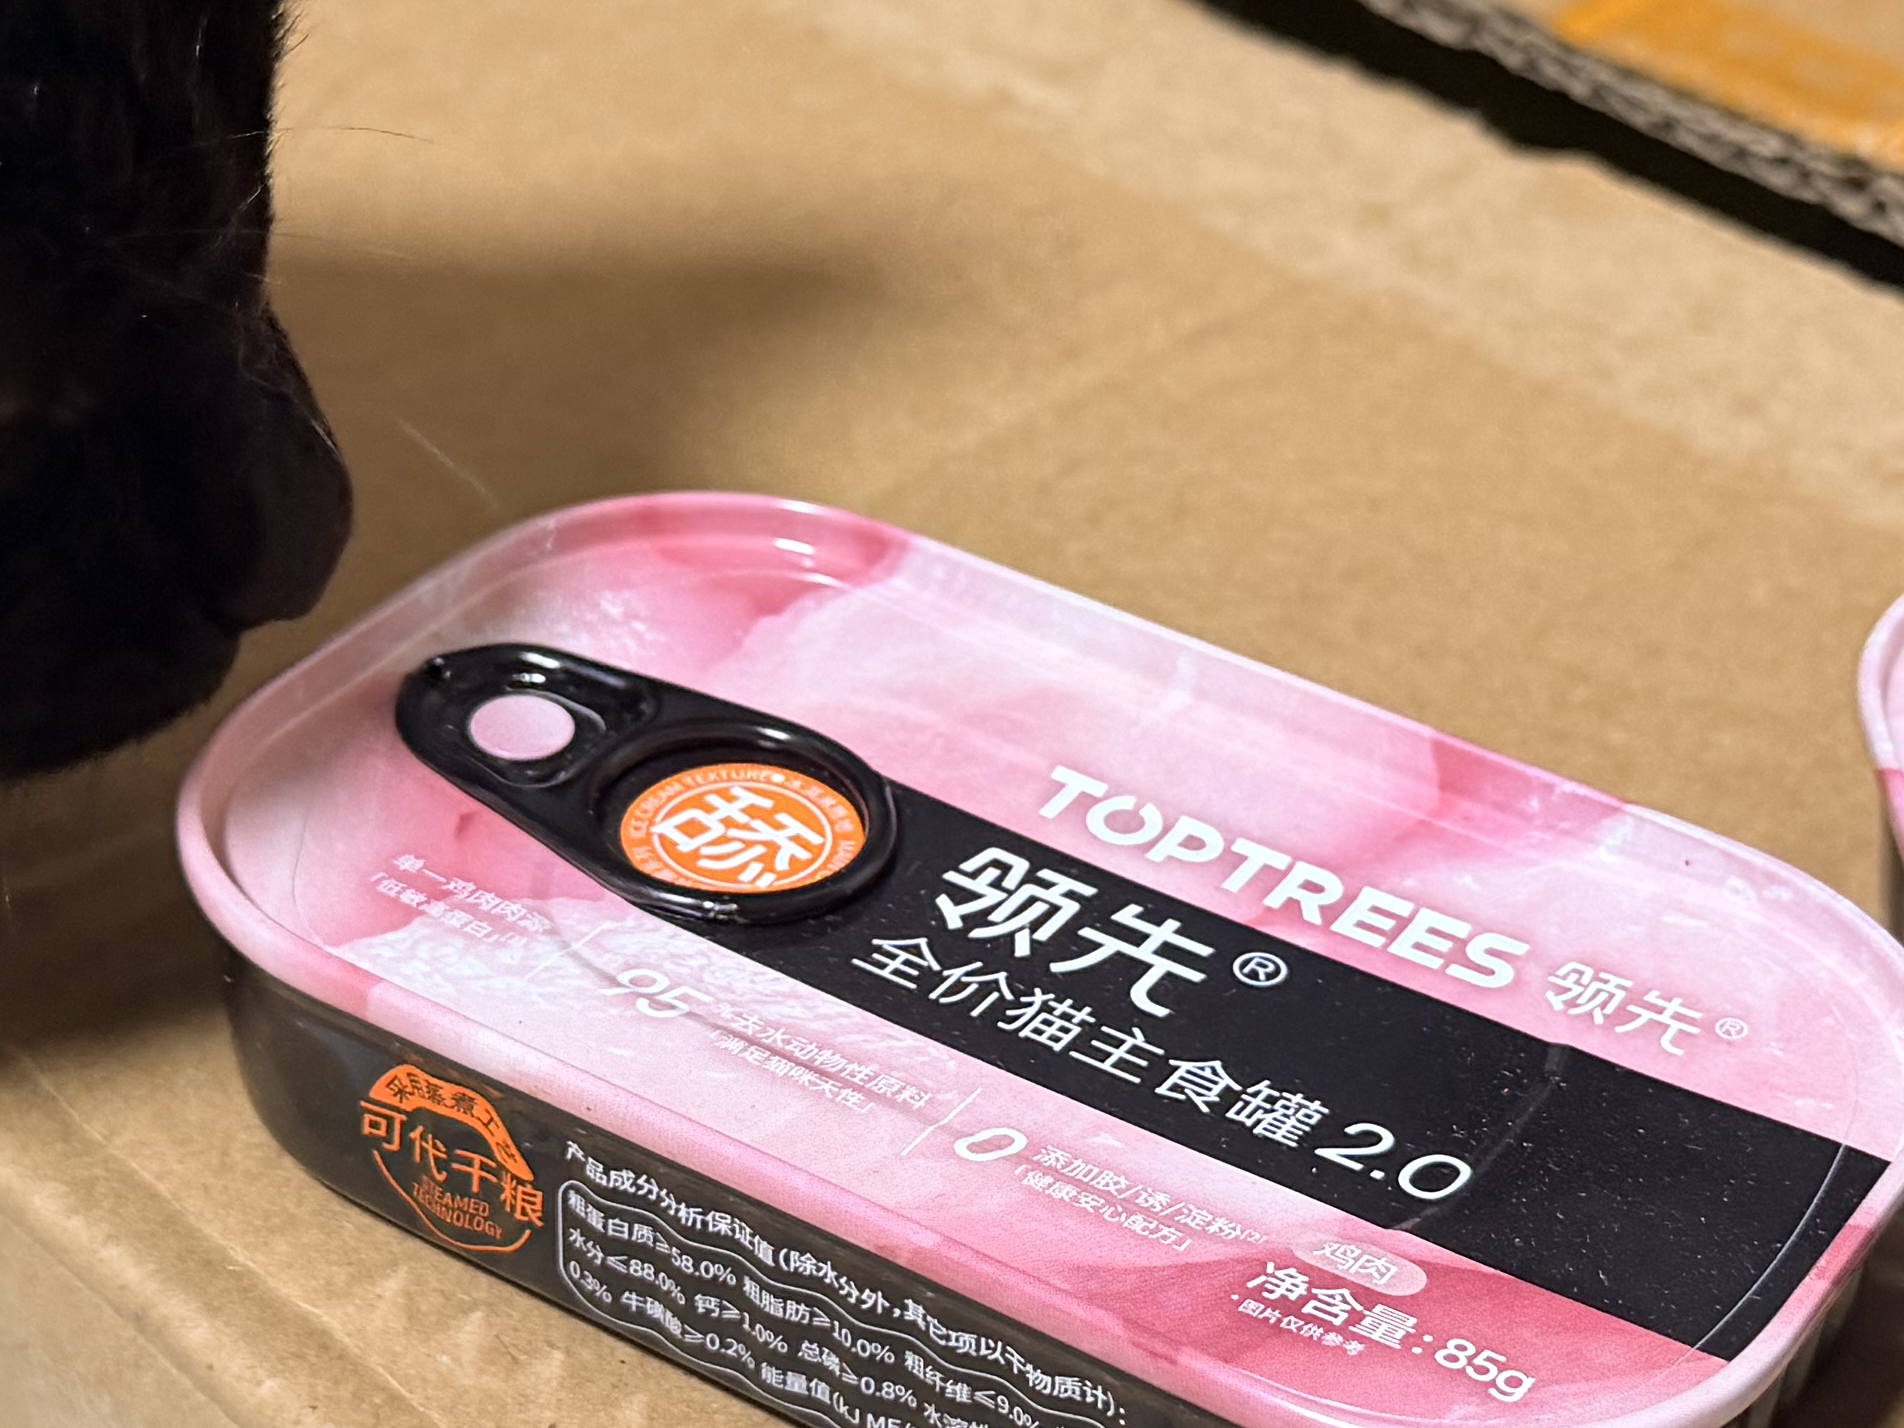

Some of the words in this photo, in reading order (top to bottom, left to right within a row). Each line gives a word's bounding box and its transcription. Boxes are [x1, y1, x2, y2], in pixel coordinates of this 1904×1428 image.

[1048, 764, 1530, 993] TOPTREES
[849, 925, 1332, 1150] 全价猫主食罐
[1319, 1116, 1475, 1208] 2.0
[362, 1098, 544, 1227] 可代干粮
[1310, 1236, 1400, 1286] 鸡肉
